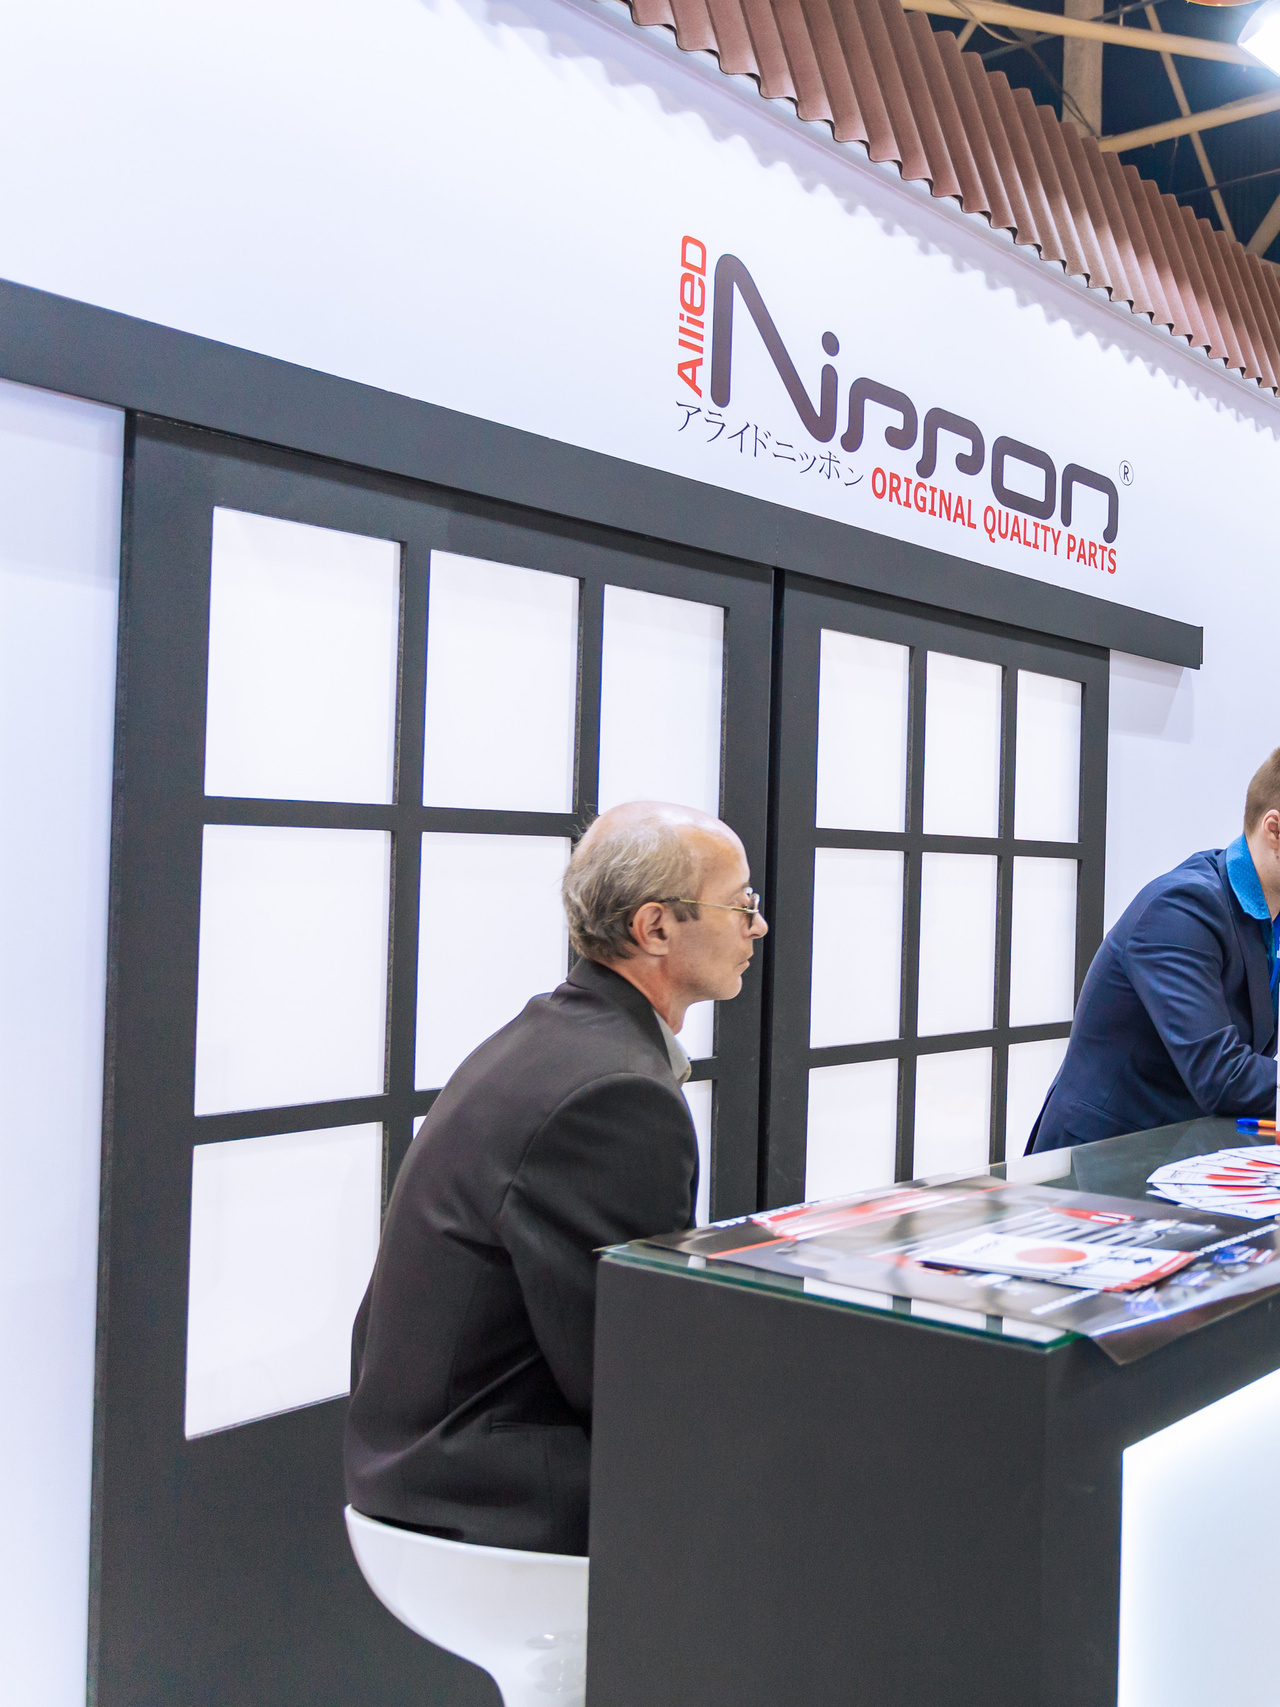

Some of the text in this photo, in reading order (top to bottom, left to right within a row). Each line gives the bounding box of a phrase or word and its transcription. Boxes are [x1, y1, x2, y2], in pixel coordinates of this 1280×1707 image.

[675, 400, 864, 487] アライドニッポン
[871, 466, 1118, 575] ORIGINAL QUALITY PARTS
